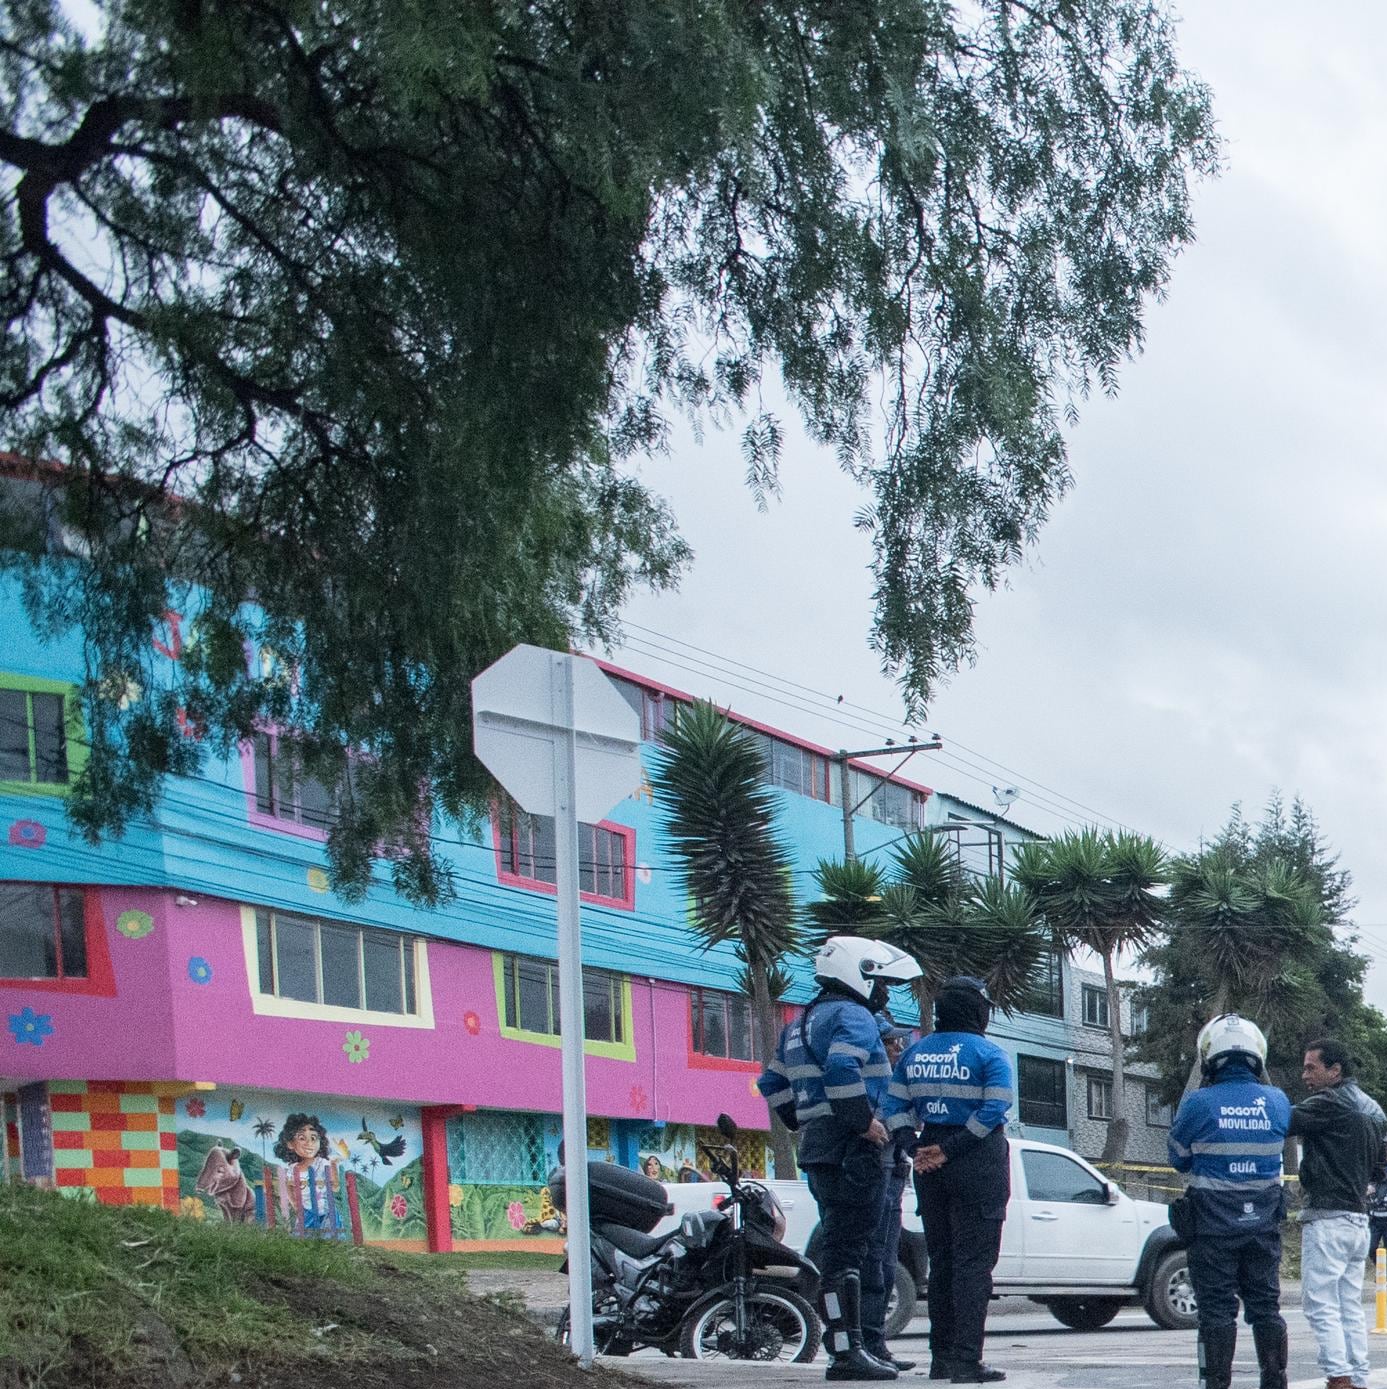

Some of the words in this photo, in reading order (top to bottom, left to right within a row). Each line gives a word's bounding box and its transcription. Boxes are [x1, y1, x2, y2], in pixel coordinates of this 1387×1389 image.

[906, 1064, 971, 1080] MOVILIDAD
[1218, 1118, 1271, 1131] MOVILIDAD
[1229, 1161, 1257, 1174] GUÍA
